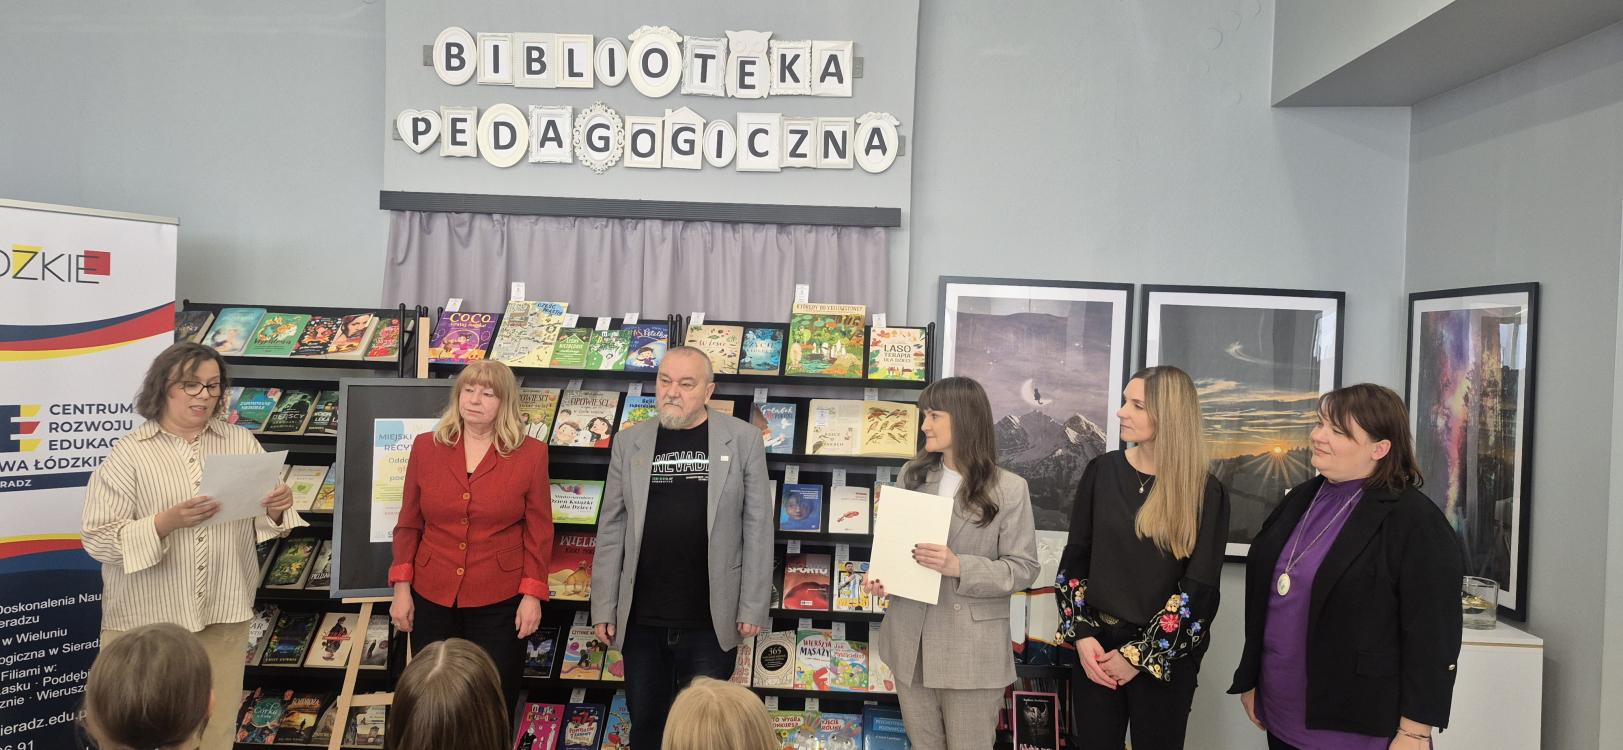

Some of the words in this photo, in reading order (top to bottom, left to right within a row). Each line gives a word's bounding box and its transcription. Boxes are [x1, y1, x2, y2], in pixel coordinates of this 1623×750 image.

[444, 42, 845, 90] BIBLIOTEKA
[412, 116, 888, 160] PEDAGOGICZNA
[449, 313, 491, 323] COCO
[884, 344, 912, 353] LASO
[49, 403, 133, 416] CENTRUM
[49, 420, 133, 433] ROZWOJU
[49, 437, 119, 451] EDUKAC
[378, 433, 412, 442] MIEJSKI
[384, 444, 412, 452] RECY
[0, 460, 29, 472] WA
[34, 456, 107, 470] ŁÓDZKIE
[653, 451, 709, 472] NEVAD
[0, 480, 32, 488] RADZ
[79, 593, 102, 603] Nau
[0, 615, 40, 628] eradzu
[2, 638, 12, 646] w
[16, 628, 68, 644] Wieluniu
[0, 649, 45, 666] ogiczna
[49, 648, 59, 656] w
[62, 638, 101, 653] Sierad
[800, 646, 830, 657] MASAŻY
[1, 665, 41, 681] Filiami
[0, 682, 31, 695] asku
[0, 697, 24, 709] znie
[0, 710, 87, 736] ieradz.edu.p
